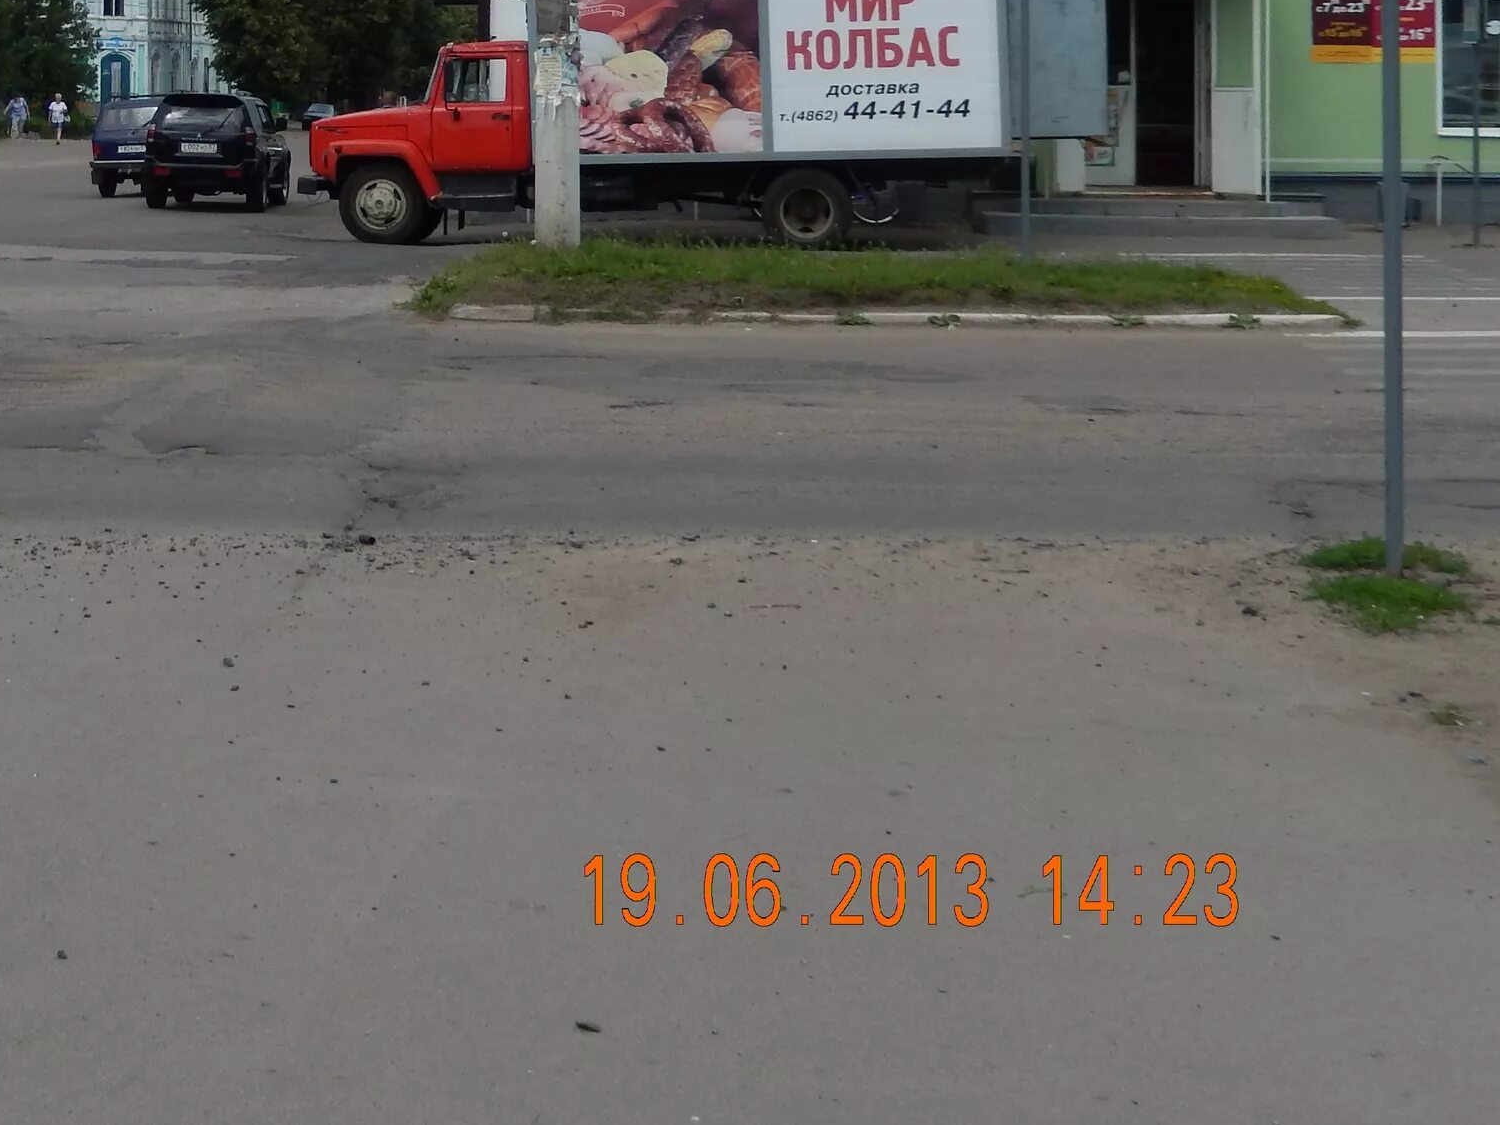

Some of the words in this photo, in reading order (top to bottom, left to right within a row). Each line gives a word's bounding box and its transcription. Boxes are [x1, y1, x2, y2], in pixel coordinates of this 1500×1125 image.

[785, 25, 961, 71] КОЛБАС
[826, 80, 921, 99] доставка
[779, 110, 838, 123] т.(4862)
[843, 98, 971, 120] 44-41-44
